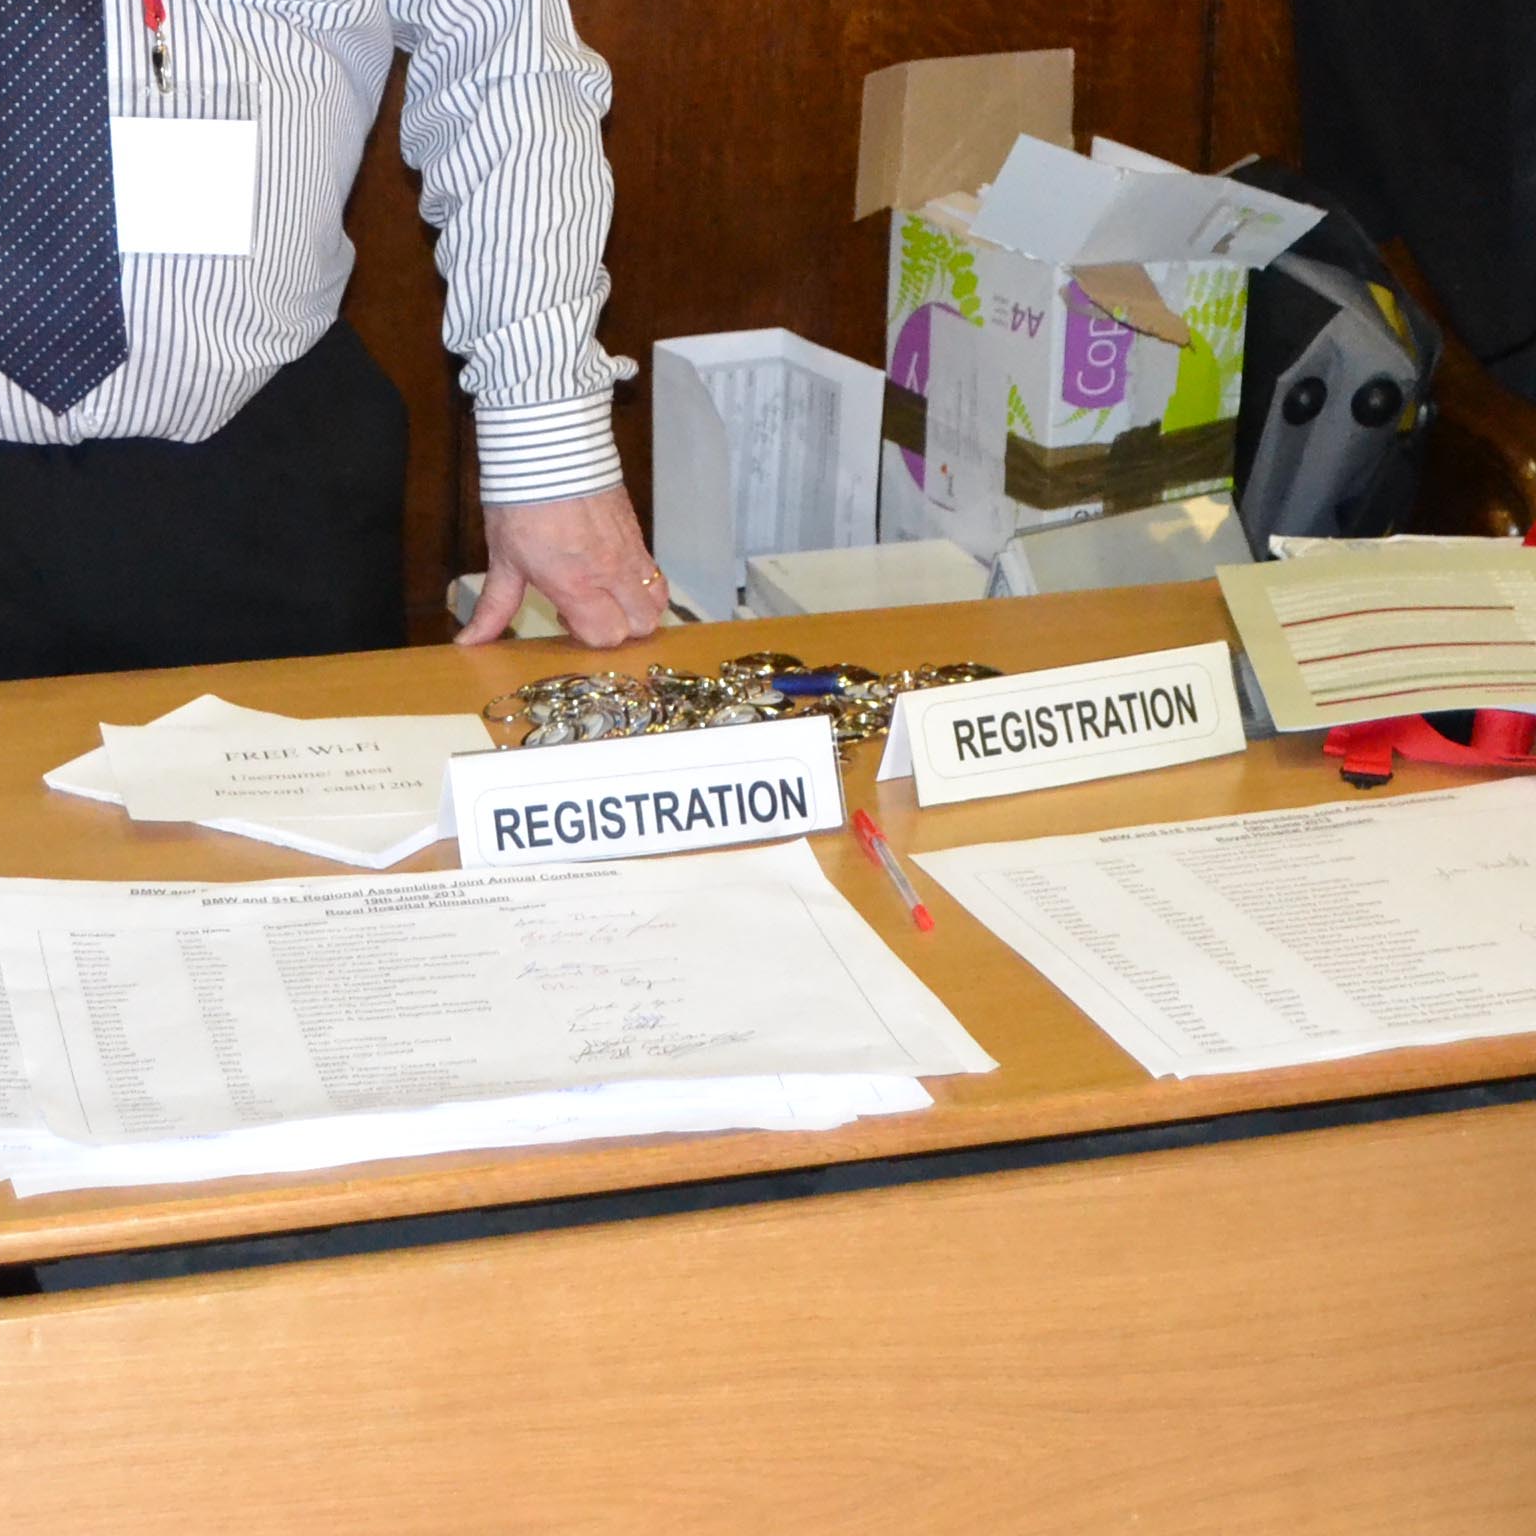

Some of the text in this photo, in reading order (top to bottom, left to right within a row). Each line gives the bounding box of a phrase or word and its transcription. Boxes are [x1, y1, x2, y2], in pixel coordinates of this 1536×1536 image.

[952, 683, 1200, 762] REGISTRATION
[224, 741, 381, 763] FREE Wi-Fi
[230, 766, 393, 782] Username: guest
[214, 788, 306, 797] Password:
[493, 776, 810, 852] REGISTRATION
[201, 897, 239, 907] BMW
[243, 895, 269, 905] and
[302, 889, 364, 904] Regional
[367, 883, 447, 897] Assemblies
[450, 879, 485, 890] Joint
[487, 874, 537, 888] Annual
[540, 868, 623, 882] Conference
[363, 889, 468, 906] 19th June 2013
[324, 894, 512, 918] Royal Hospital Kilmainham
